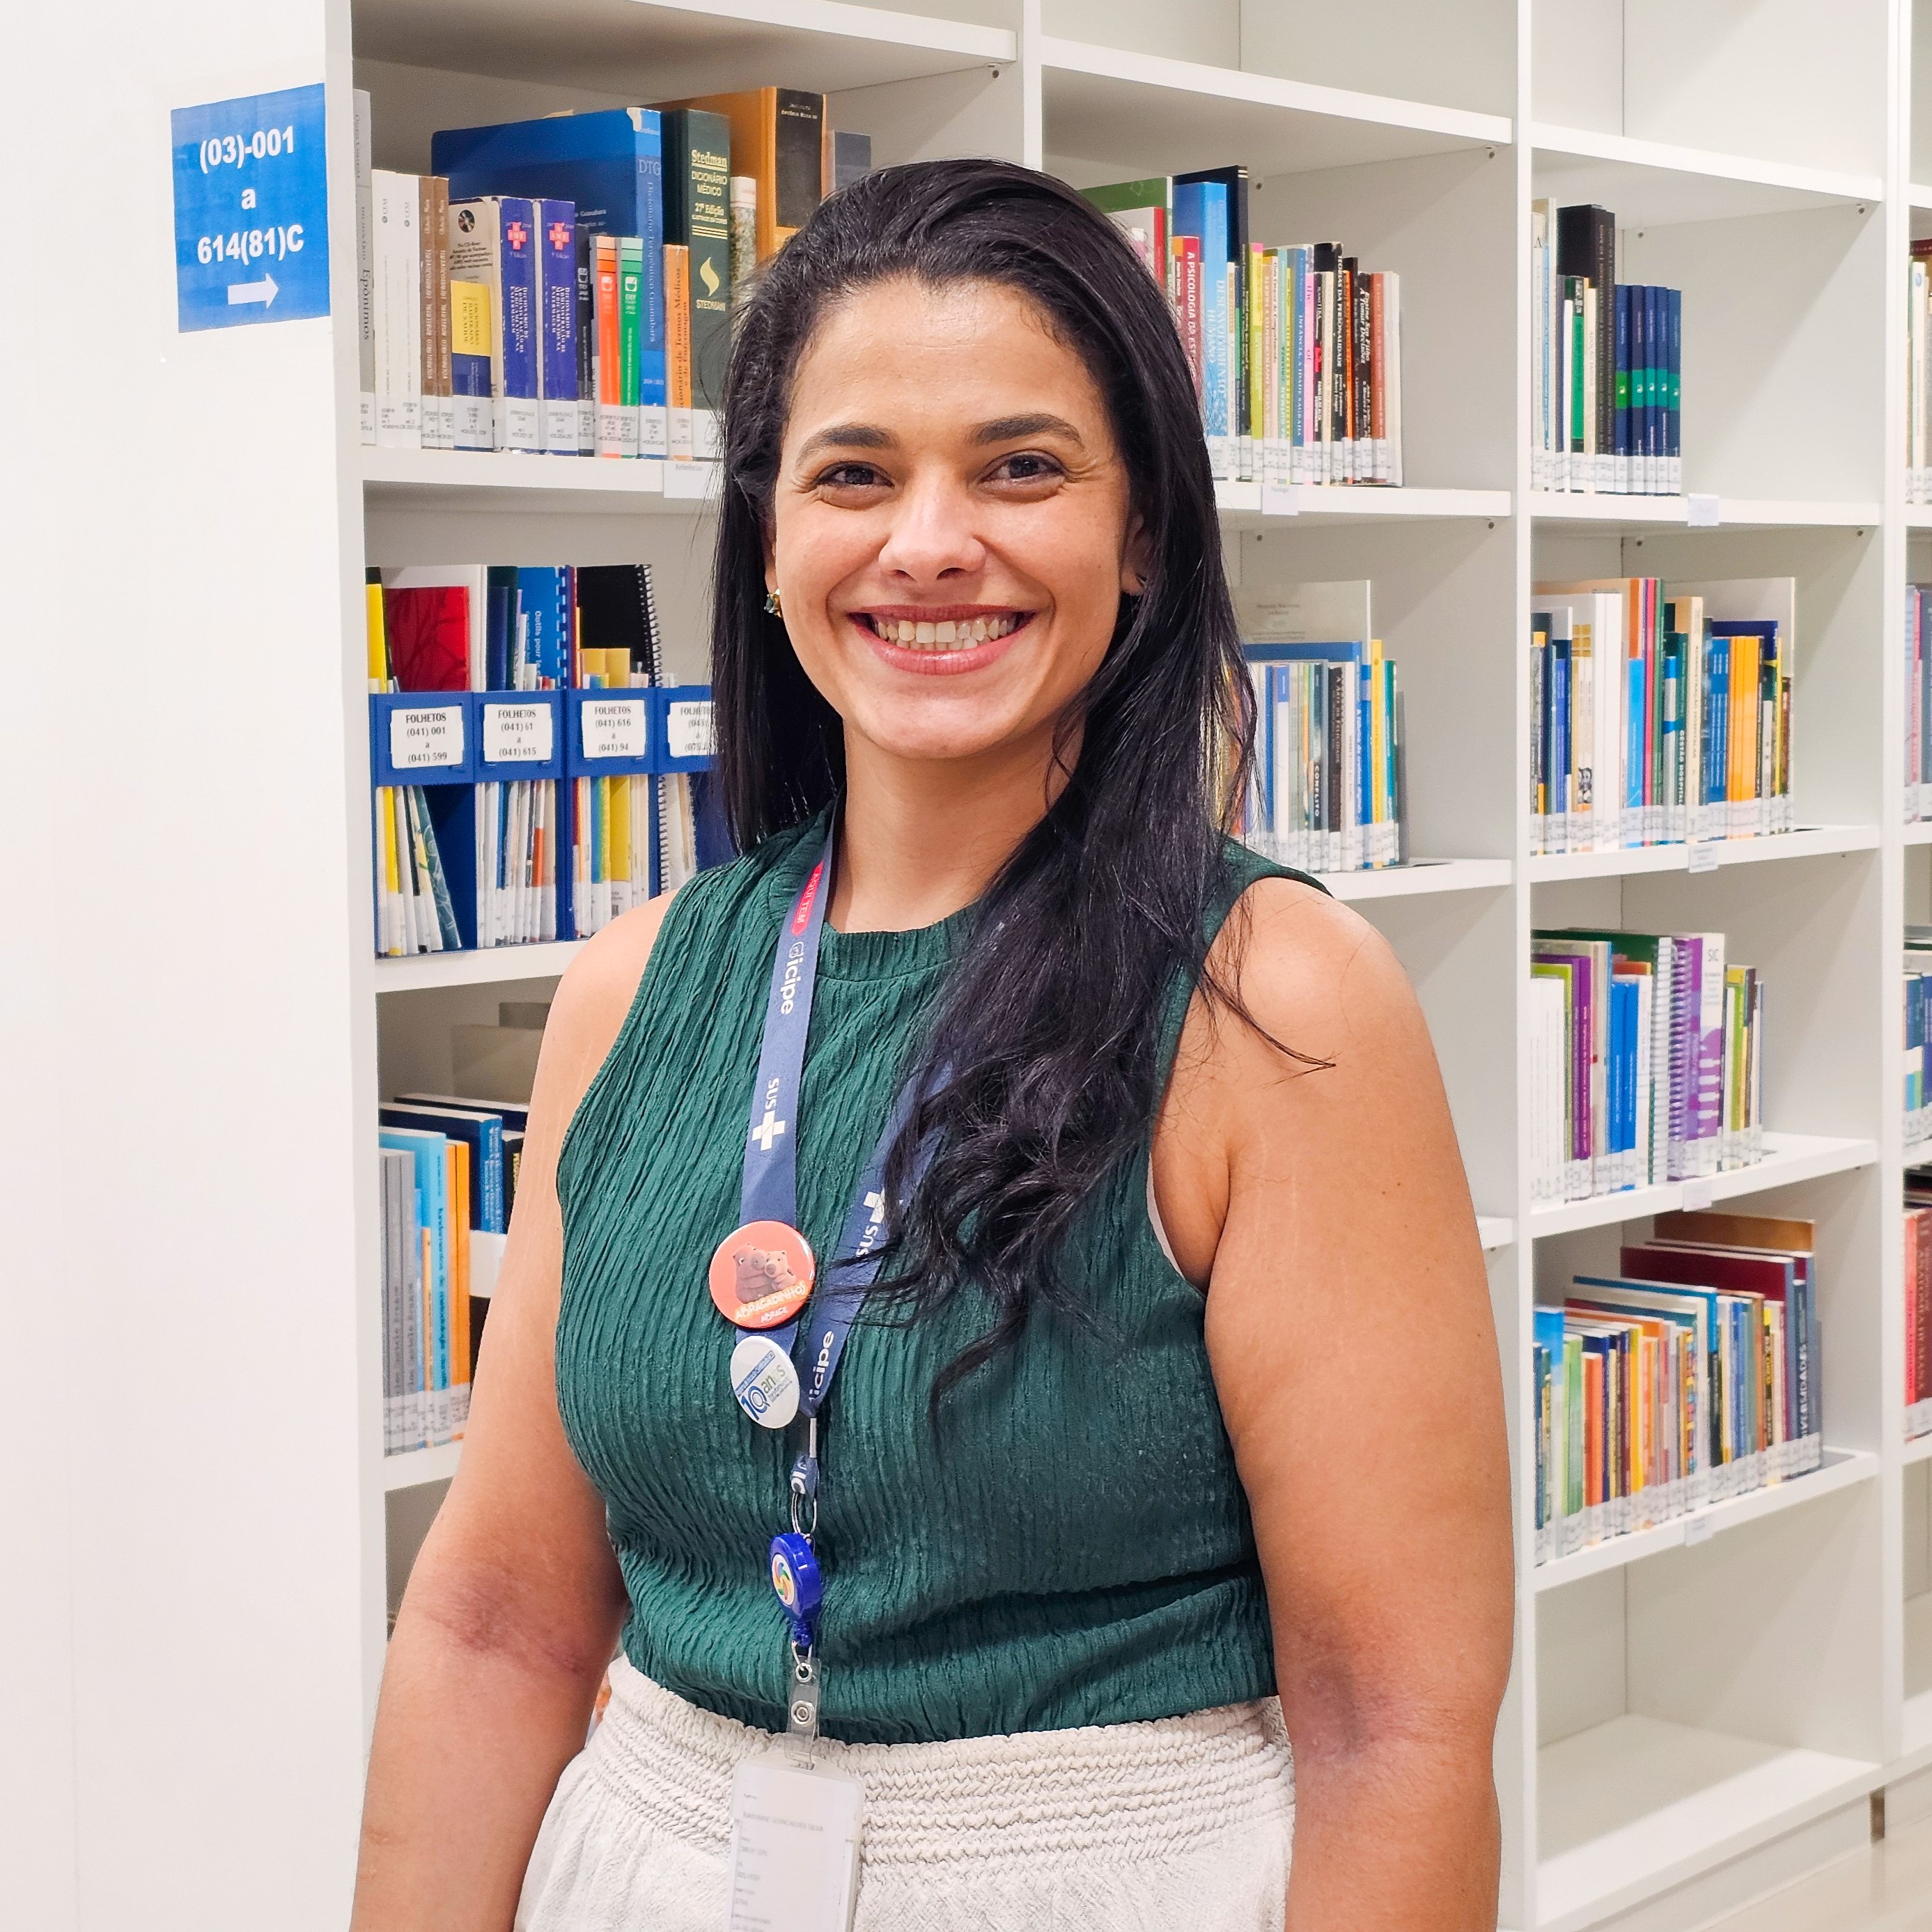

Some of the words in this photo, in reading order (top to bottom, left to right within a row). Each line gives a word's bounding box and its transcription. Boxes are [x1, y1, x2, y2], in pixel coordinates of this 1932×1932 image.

[199, 125, 294, 174] (03)-001
[692, 150, 727, 165] Stedman
[639, 159, 660, 176] DTG
[692, 171, 727, 185] DICIONÁRIO
[697, 182, 722, 196] MÉDICO
[241, 188, 257, 210] a
[197, 224, 304, 265] 614(81)C
[1187, 262, 1195, 318] PSICOLOGIA
[1337, 289, 1342, 301] DA
[361, 268, 371, 340] Epônimos
[696, 299, 726, 311] STEDMAN
[1216, 280, 1226, 394] DESENVOLVIMENTO
[533, 638, 541, 657] pour
[498, 710, 536, 719] FOLHETOS
[595, 706, 631, 715] FOLHETOS
[405, 713, 446, 724] FOLHETOS
[595, 719, 615, 728] (041)
[407, 727, 429, 736] (041)
[431, 726, 446, 735] 001
[501, 723, 524, 732] (041)
[499, 748, 521, 758] (041)
[523, 747, 536, 756] 615
[598, 745, 618, 753] (041)
[408, 754, 430, 763] (041)
[433, 752, 448, 761] 599
[795, 900, 809, 924] TEM
[741, 1385, 770, 1421] 10
[761, 1364, 786, 1394] anos
